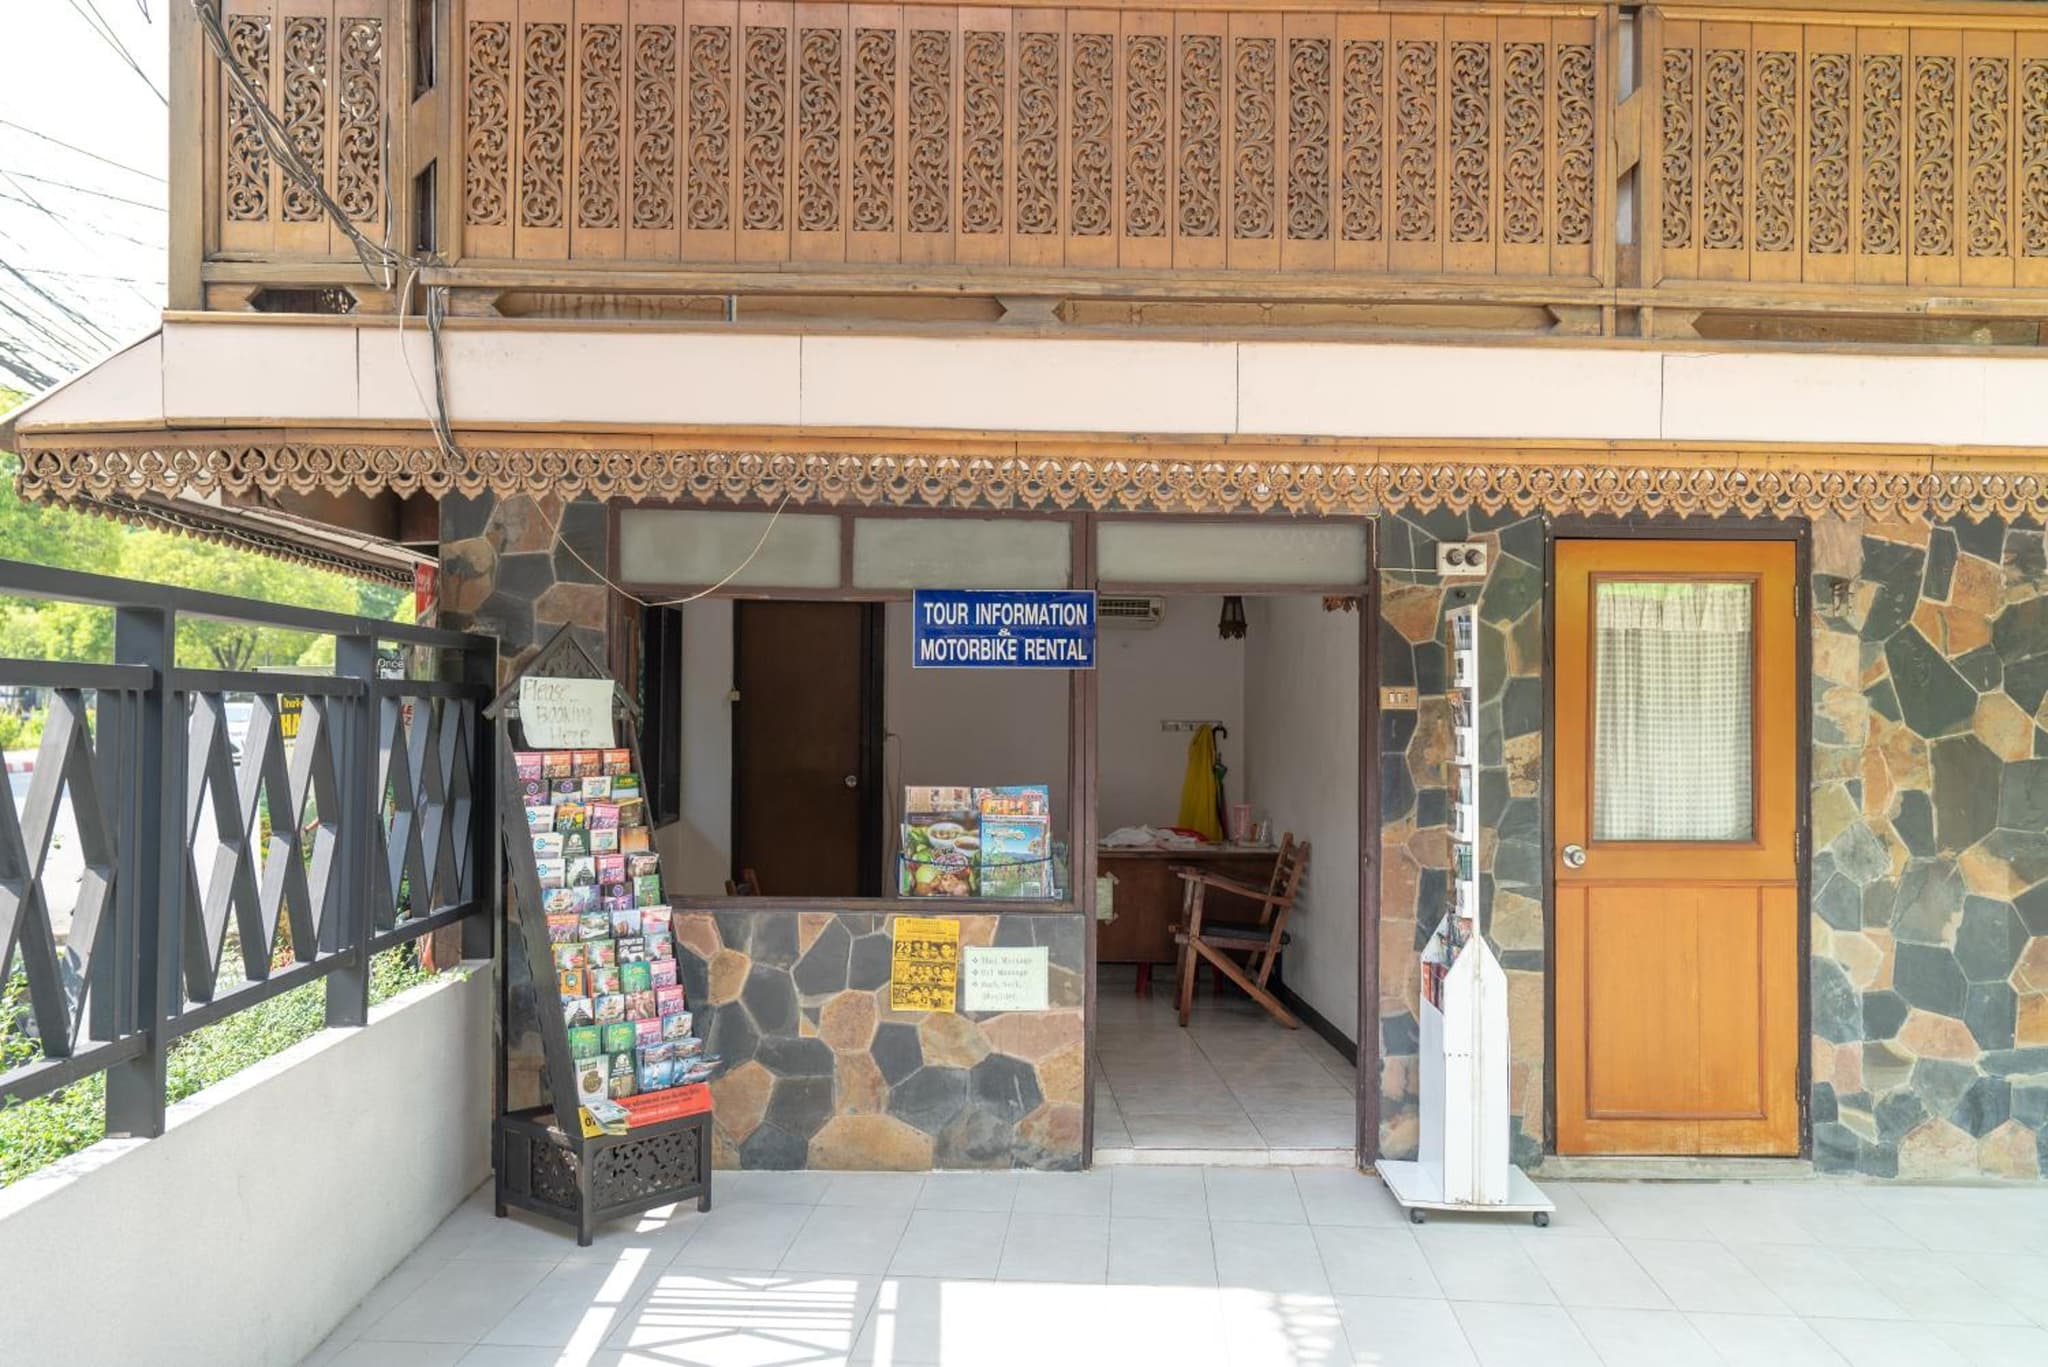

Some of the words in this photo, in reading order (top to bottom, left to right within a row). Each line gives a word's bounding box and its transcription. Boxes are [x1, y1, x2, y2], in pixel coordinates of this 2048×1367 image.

[924, 603, 968, 625] TOUR
[976, 603, 1087, 625] INFORMATION
[998, 627, 1011, 637] &
[921, 639, 1017, 661] MOTORBIKE
[1025, 639, 1087, 661] RENTAL
[896, 942, 912, 954] 23
